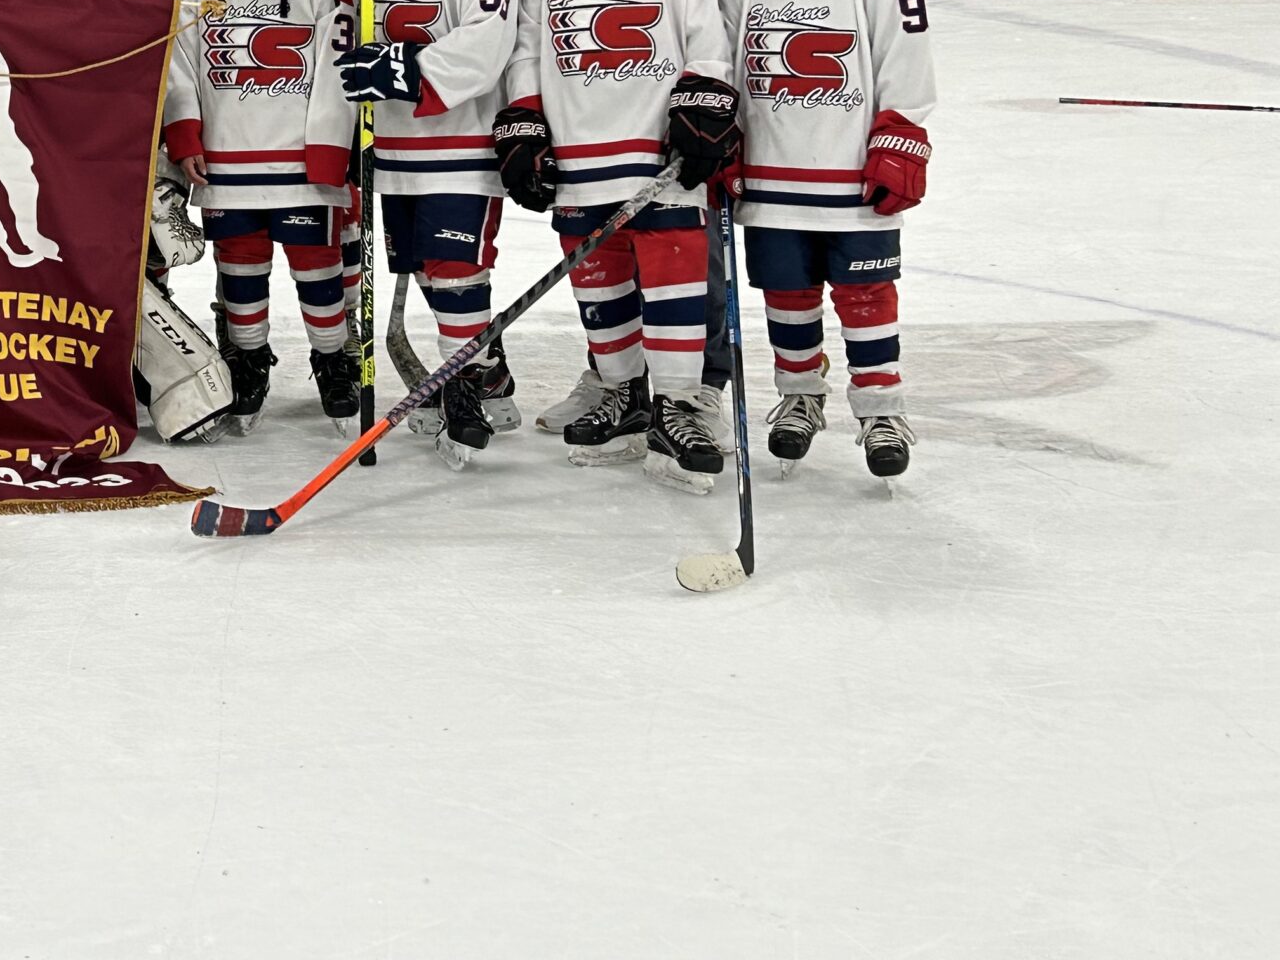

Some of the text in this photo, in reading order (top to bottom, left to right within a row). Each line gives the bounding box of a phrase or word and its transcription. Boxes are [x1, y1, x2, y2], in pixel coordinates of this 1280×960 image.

[747, 4, 831, 27] Spokane
[614, 59, 677, 81] Chiefs
[802, 86, 865, 108] Chiefs
[148, 310, 195, 356] CCM
